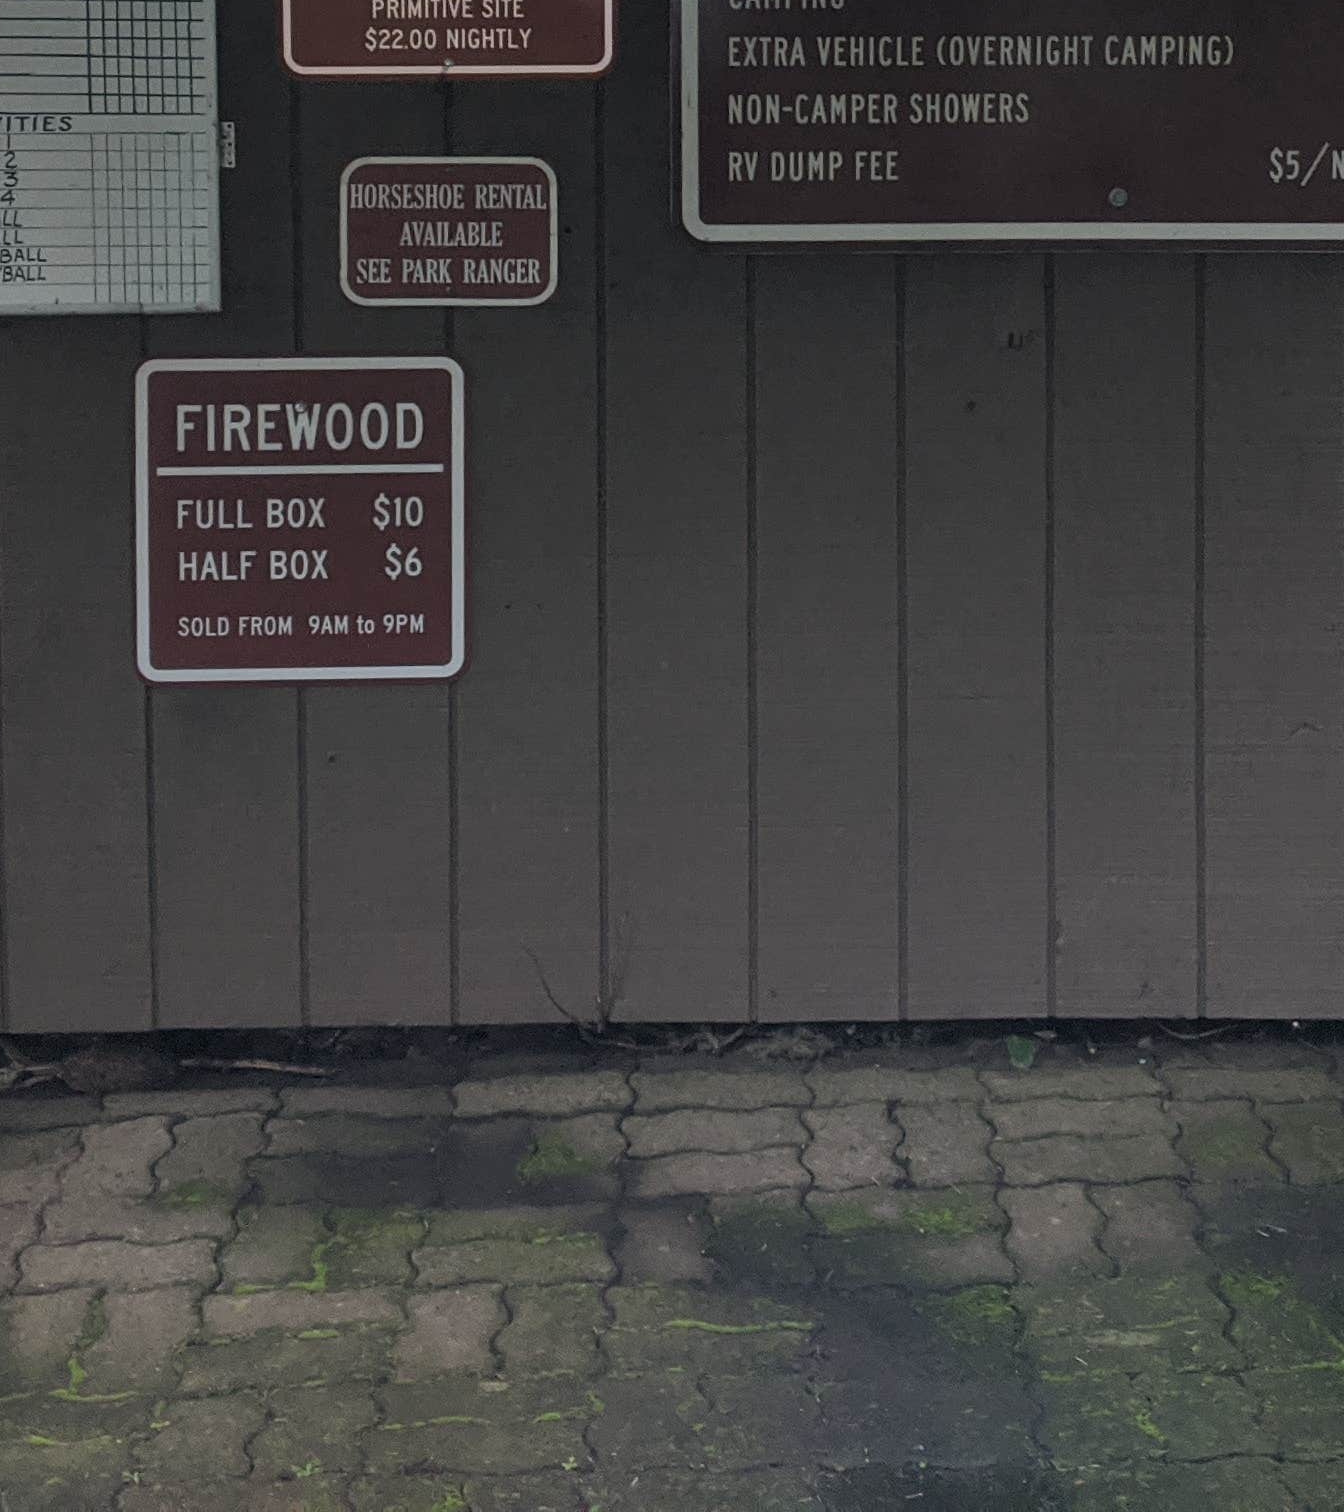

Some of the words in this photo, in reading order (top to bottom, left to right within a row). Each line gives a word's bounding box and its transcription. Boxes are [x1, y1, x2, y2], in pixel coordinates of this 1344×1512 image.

[364, 26, 437, 52] $22.00
[446, 28, 532, 49] NIGHTLY
[728, 36, 806, 67] EXTRA
[816, 36, 925, 67] VEHICLE
[937, 35, 1093, 68] (OVERNIGHT
[1105, 35, 1235, 67] CAMPING)
[728, 93, 898, 125] NON-CAMPER
[909, 92, 1029, 124] SHOWERS
[3, 151, 16, 167] 2
[728, 151, 759, 182] RV
[771, 151, 843, 182] DUMP
[855, 150, 899, 181] FEE
[3, 171, 18, 188] 3
[0, 190, 15, 206] 4
[350, 184, 464, 209] HORSESHOE
[475, 184, 546, 209] RENTAL
[399, 221, 503, 247] AVAILABLE
[356, 258, 392, 284] SEE
[401, 258, 453, 284] PARK
[463, 258, 541, 284] RANGER
[176, 403, 424, 451] FIREWOOD
[177, 499, 253, 530] FULL
[266, 497, 325, 529] BOX
[373, 492, 424, 531] $10
[179, 550, 257, 581] HALF
[270, 549, 329, 580] BOX
[384, 542, 423, 581] $6
[177, 616, 230, 637] SOLD
[238, 615, 293, 636] FROM
[308, 614, 349, 635] 9AM
[356, 615, 375, 635] to
[383, 613, 424, 634] 9PM
